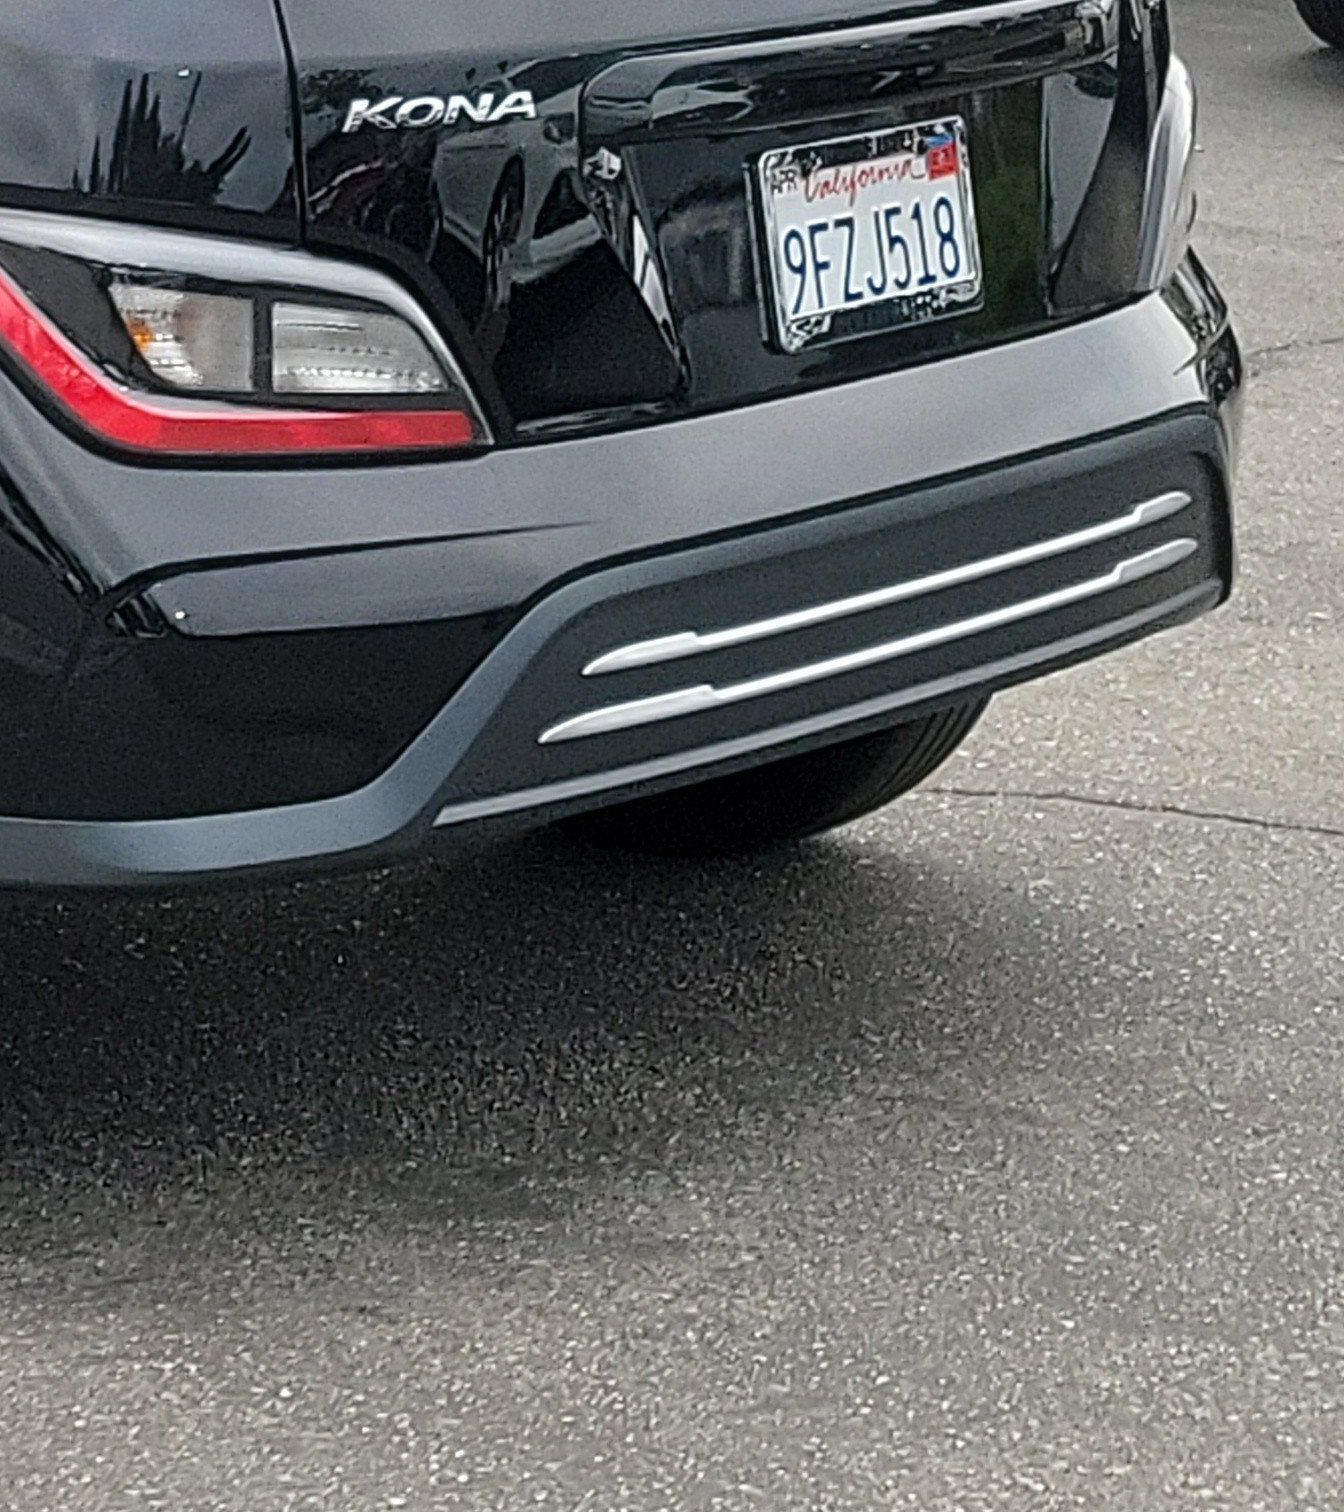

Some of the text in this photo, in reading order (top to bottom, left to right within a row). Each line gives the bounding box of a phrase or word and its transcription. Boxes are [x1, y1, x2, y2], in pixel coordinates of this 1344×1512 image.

[341, 90, 537, 134] KONA
[803, 157, 927, 206] California
[782, 196, 961, 316] 9FZJ518
